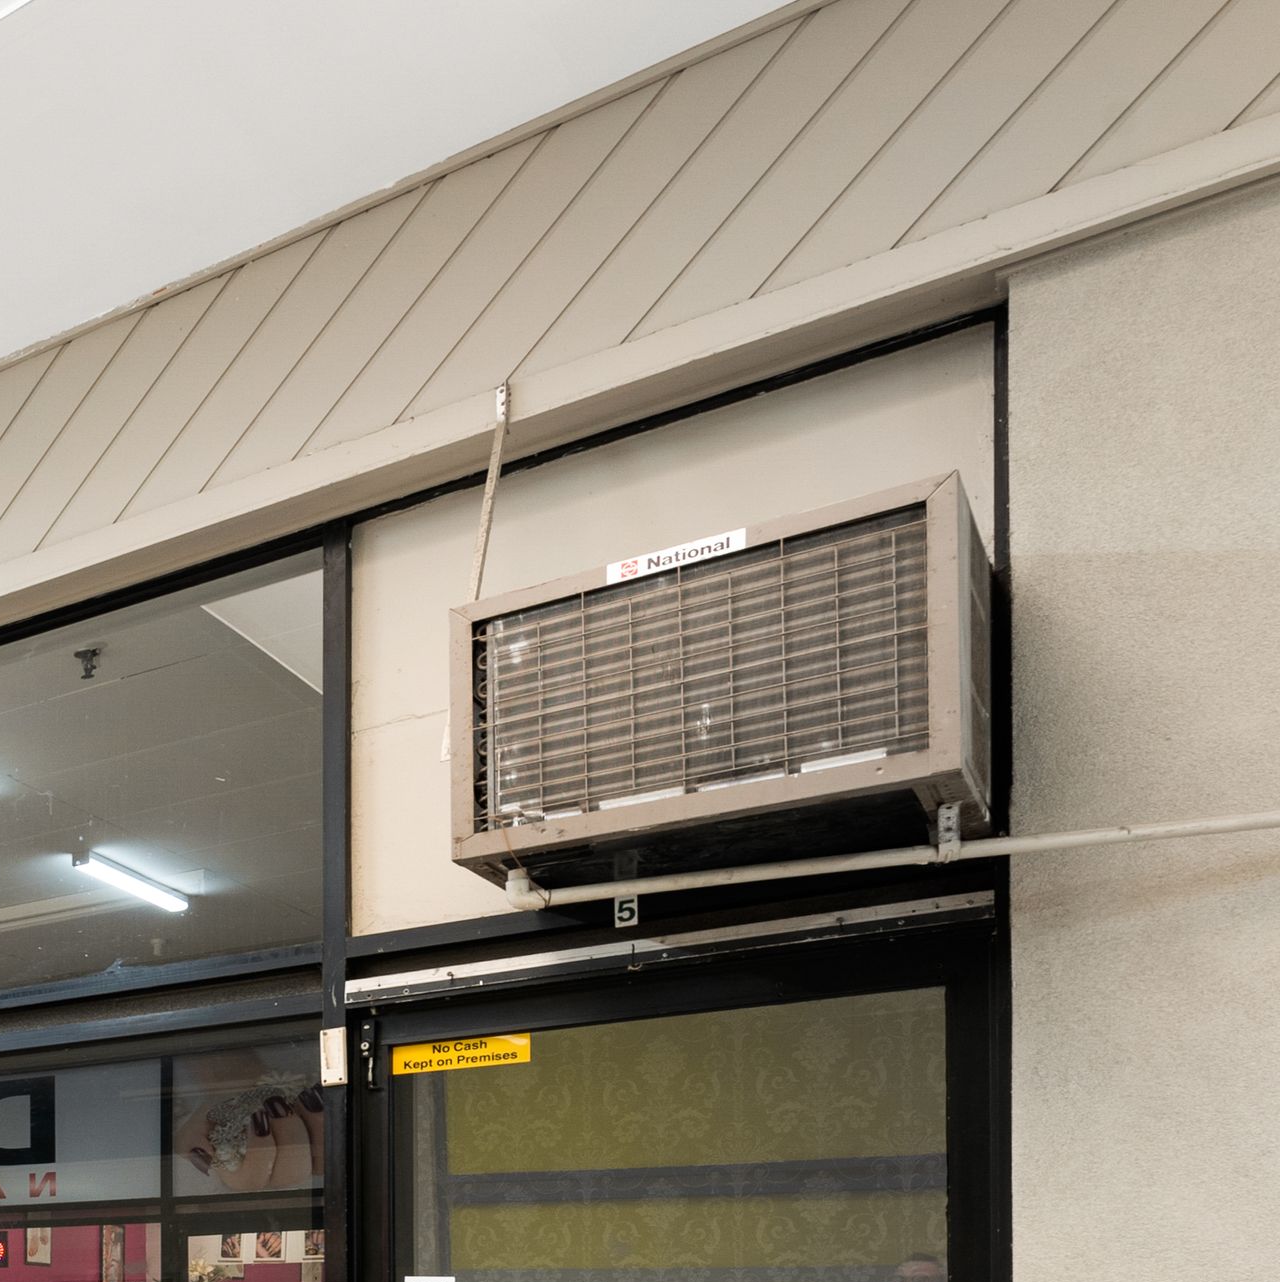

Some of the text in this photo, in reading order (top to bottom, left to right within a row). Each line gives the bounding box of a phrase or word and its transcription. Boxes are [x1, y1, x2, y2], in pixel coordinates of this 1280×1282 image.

[646, 536, 731, 570] National
[617, 898, 636, 922] 5
[432, 1040, 488, 1054] No Cash
[403, 1051, 518, 1070] Kept on Premises
